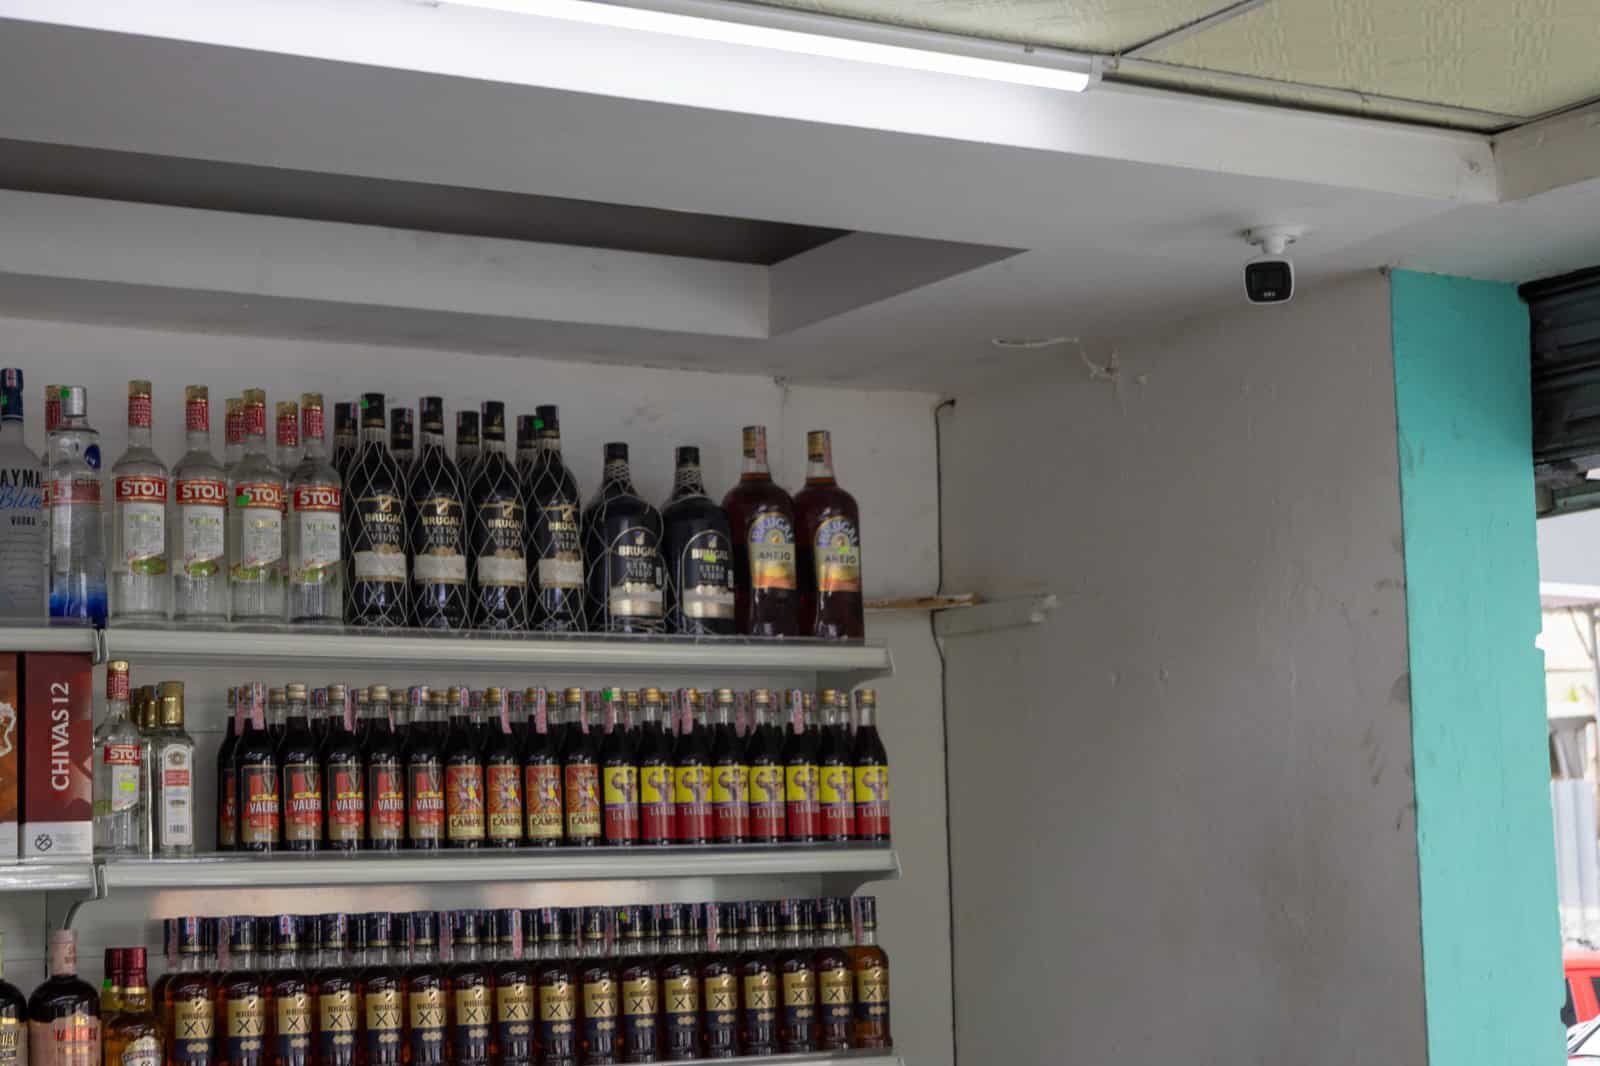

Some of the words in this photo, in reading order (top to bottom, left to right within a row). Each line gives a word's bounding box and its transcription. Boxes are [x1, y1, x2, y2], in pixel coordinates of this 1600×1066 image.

[121, 480, 165, 498] STOLI
[50, 681, 70, 704] 12
[51, 709, 70, 791] CHIVAS
